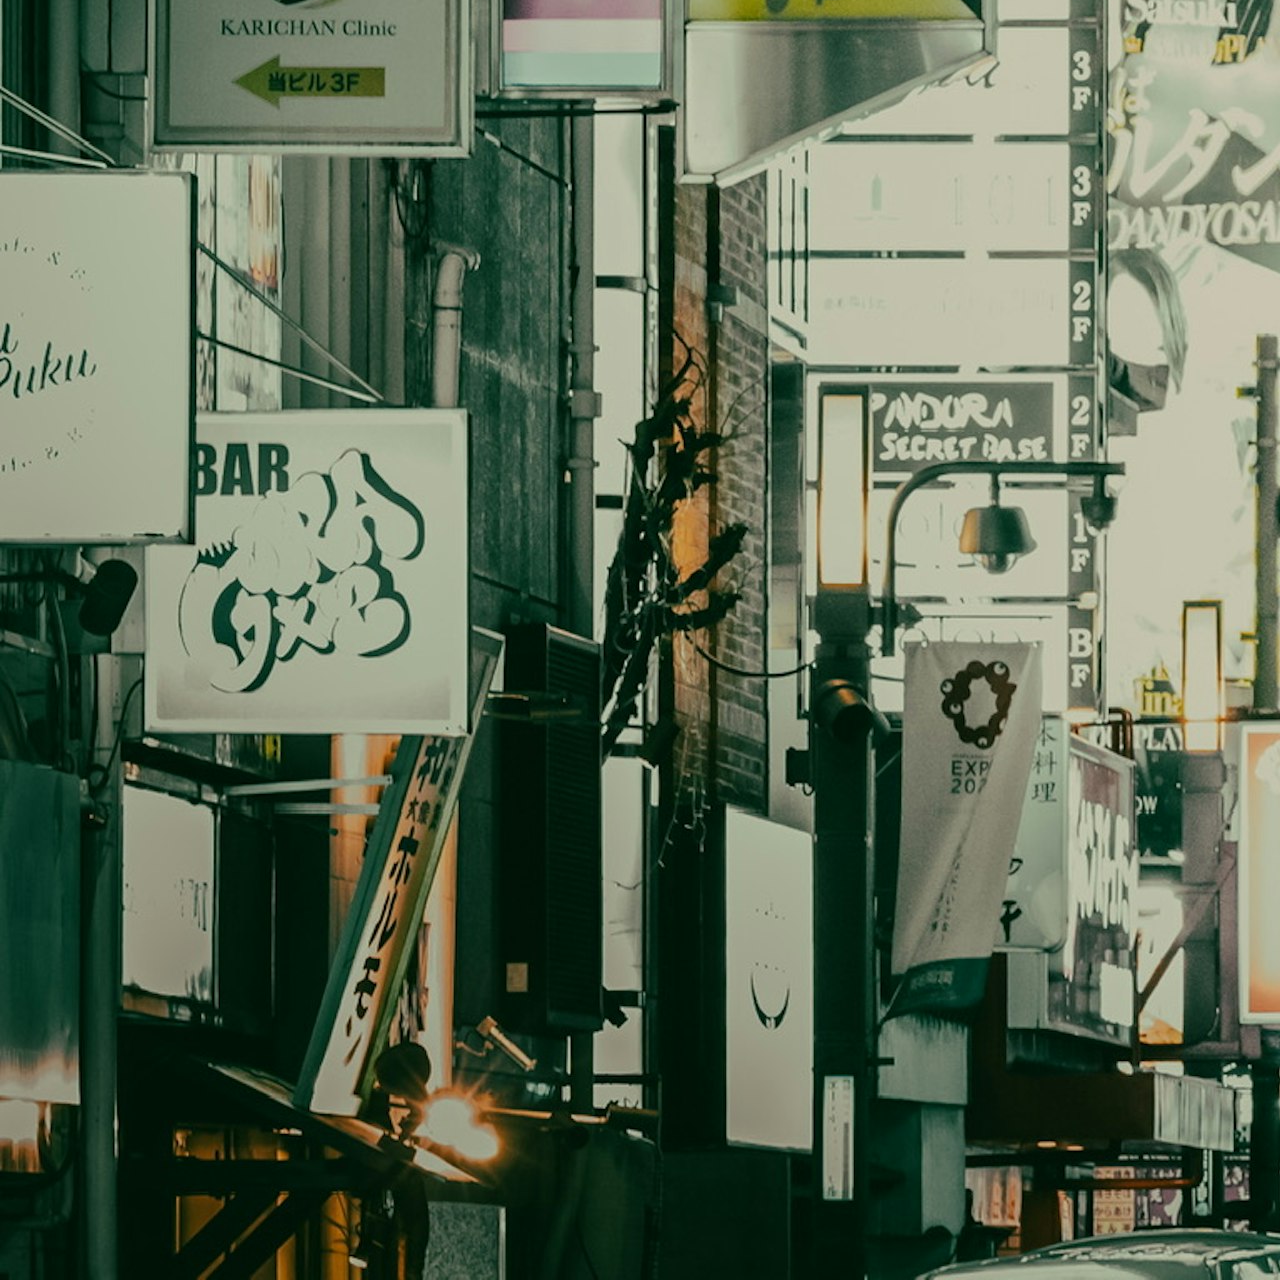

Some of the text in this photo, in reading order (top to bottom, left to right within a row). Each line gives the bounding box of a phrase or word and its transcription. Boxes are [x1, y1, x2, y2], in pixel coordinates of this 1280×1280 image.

[221, 19, 397, 37] KARICHAN Clinic
[268, 73, 360, 92] 当ビル 3F
[1072, 51, 1091, 110] 3F
[1072, 166, 1091, 225] 3F
[1072, 282, 1091, 341] 2F
[880, 433, 1047, 462] SECRET BASE
[1072, 397, 1091, 456] 2F
[195, 443, 290, 495] BAR
